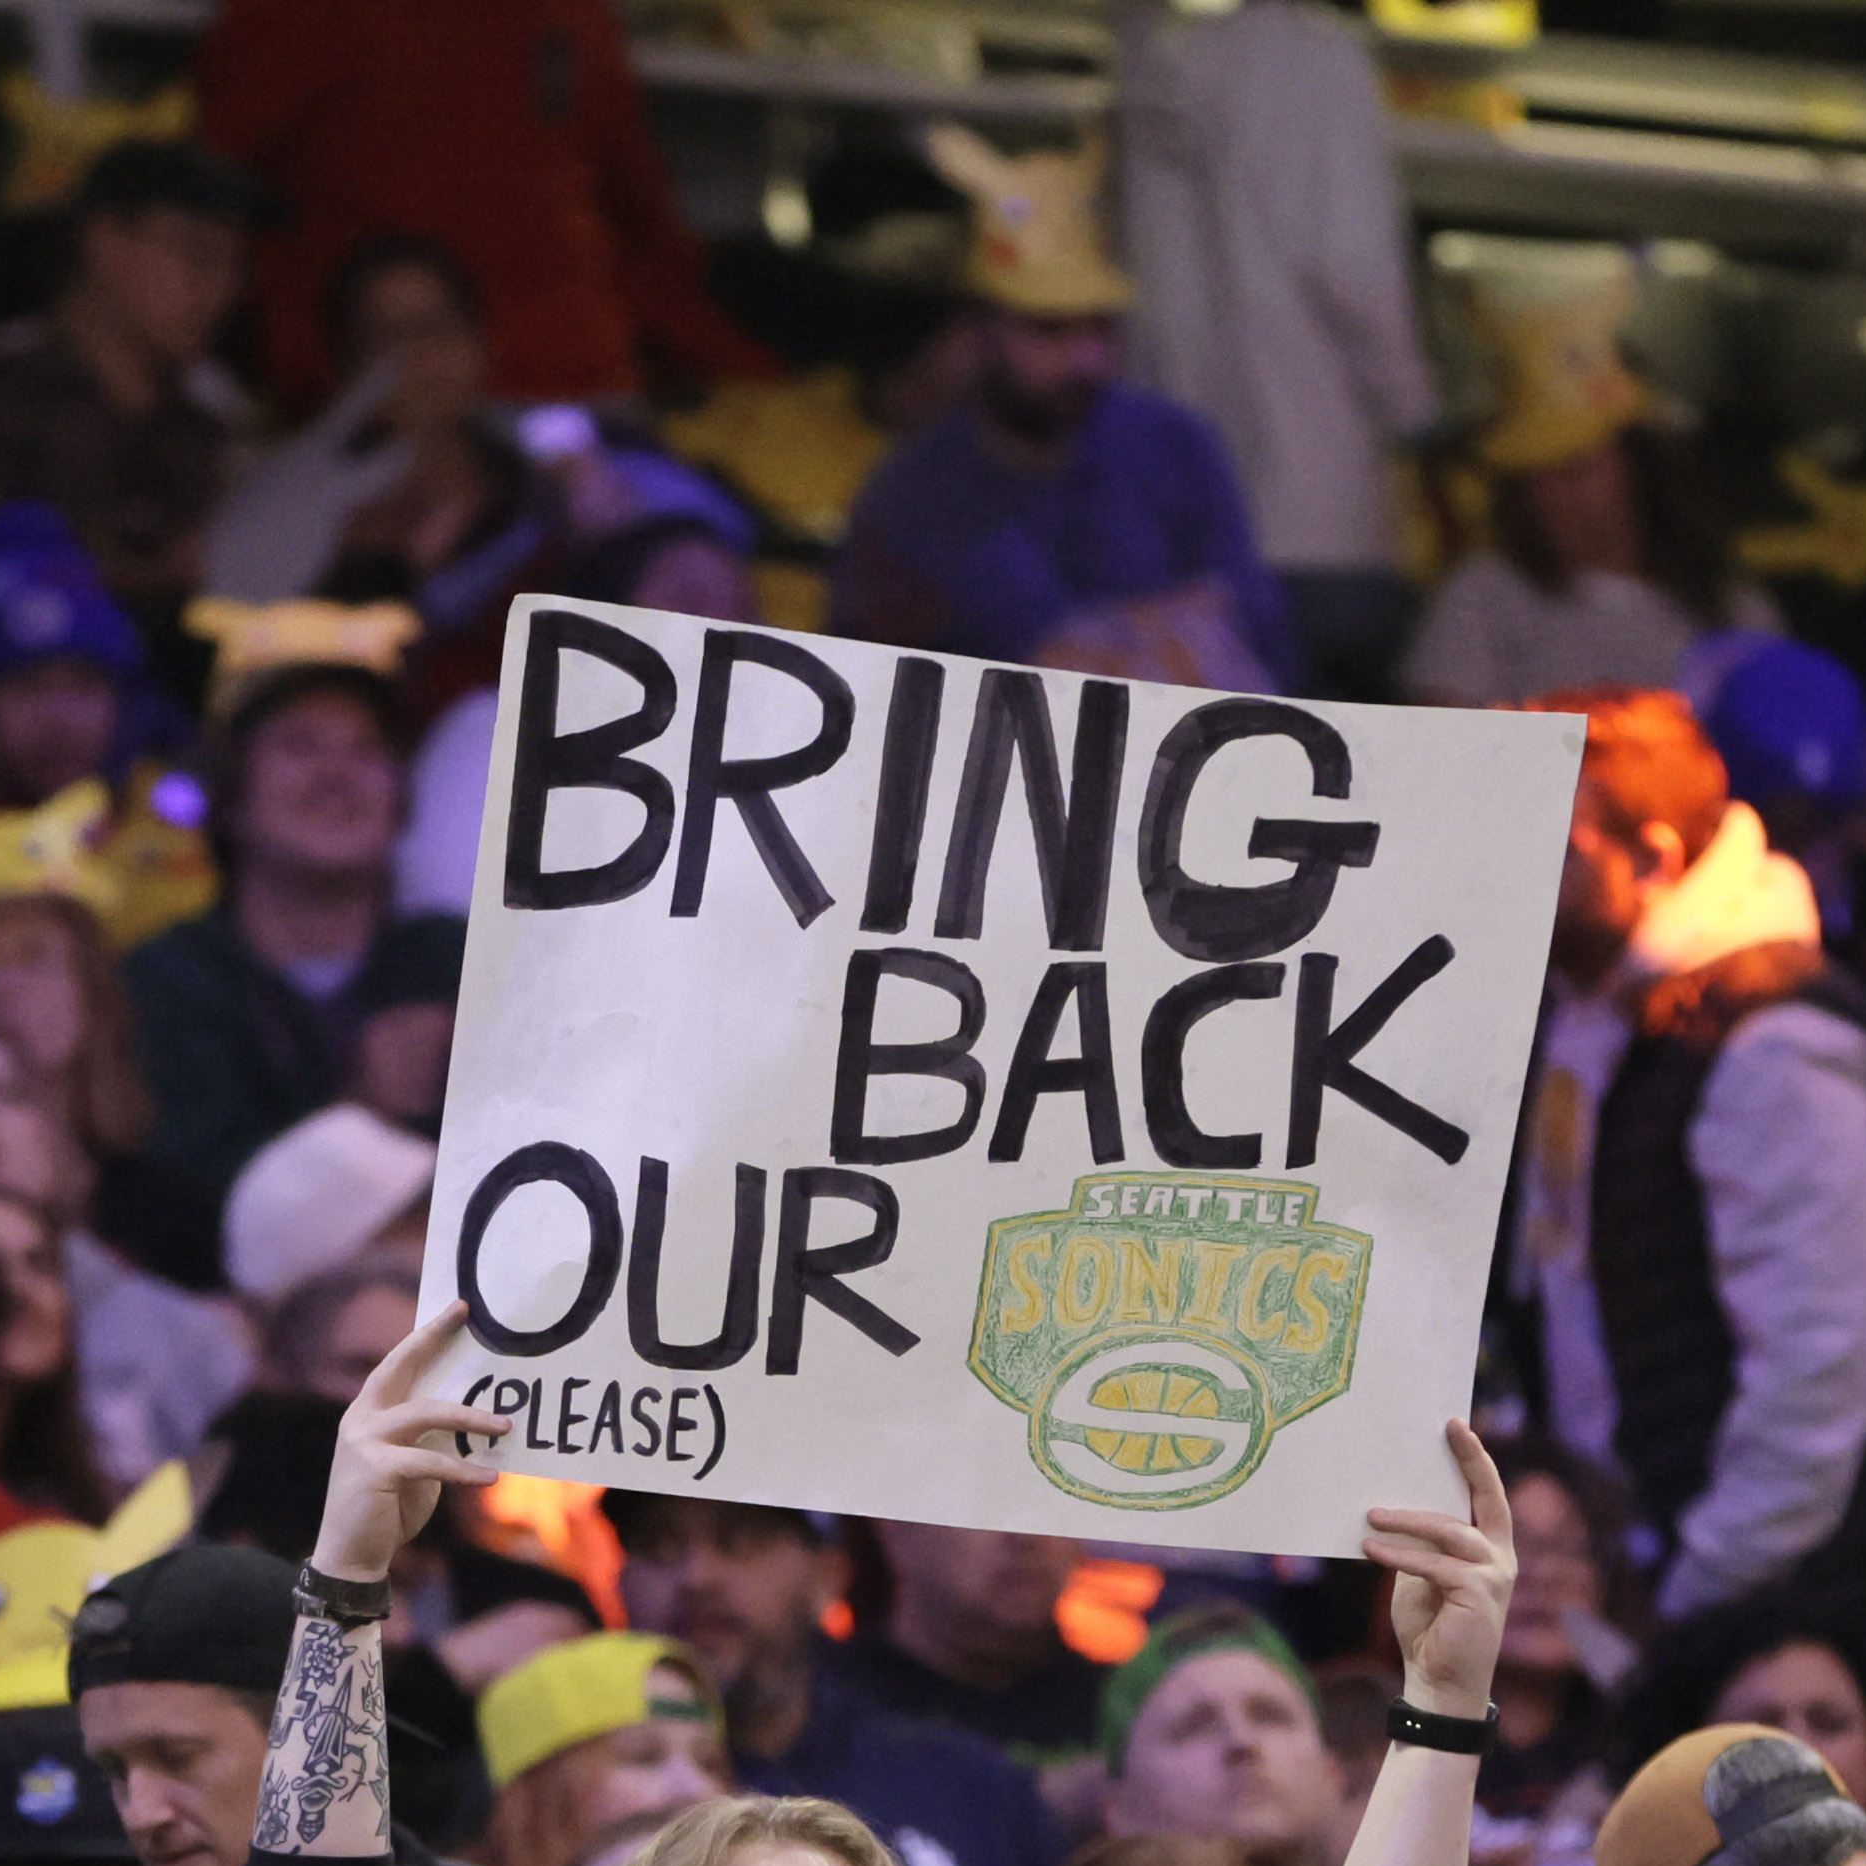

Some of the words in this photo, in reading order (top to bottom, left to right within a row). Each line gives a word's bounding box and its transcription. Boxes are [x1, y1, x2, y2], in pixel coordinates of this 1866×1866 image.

[503, 608, 1379, 960] BRING
[829, 934, 1470, 1168] BACK
[457, 1140, 921, 1376] OUR
[999, 1232, 1349, 1355] SONICS
[1084, 1184, 1305, 1227] SEATTLE
[454, 1373, 727, 1481] (PLEASE)
